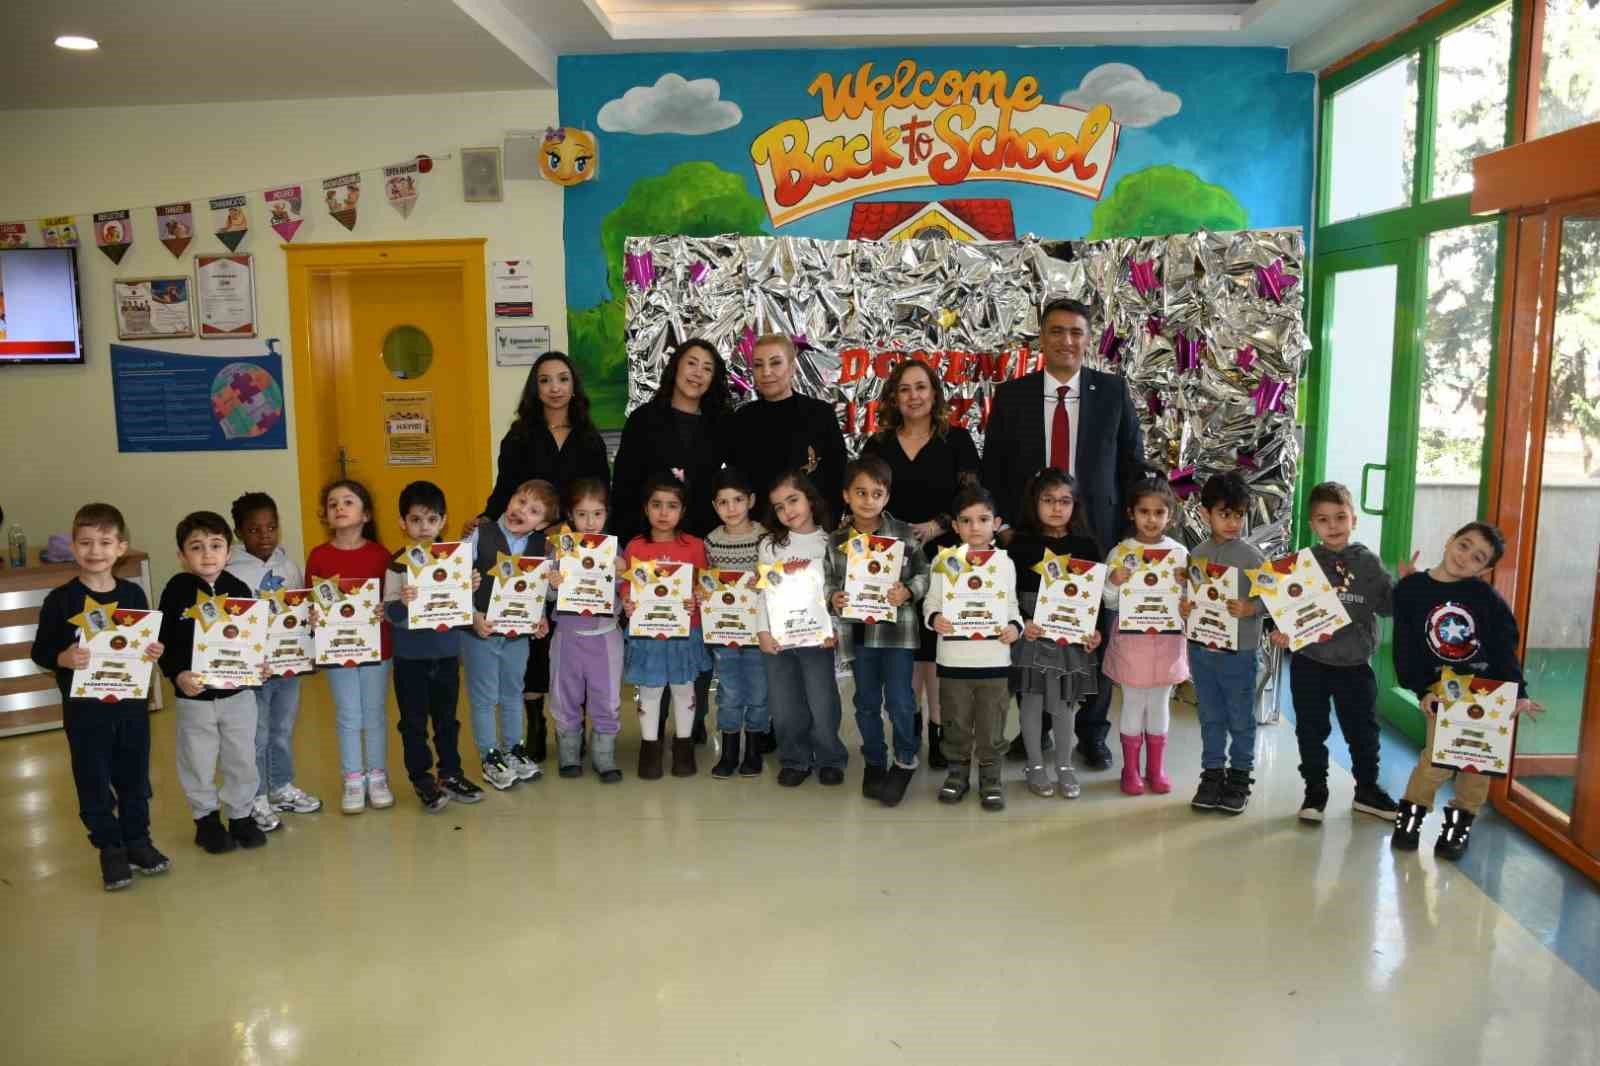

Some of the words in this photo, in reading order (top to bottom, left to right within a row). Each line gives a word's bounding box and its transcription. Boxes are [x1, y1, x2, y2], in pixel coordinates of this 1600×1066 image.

[808, 58, 1044, 121] Welcome
[750, 104, 904, 207] Back
[900, 114, 934, 166] to
[928, 103, 1112, 185] School
